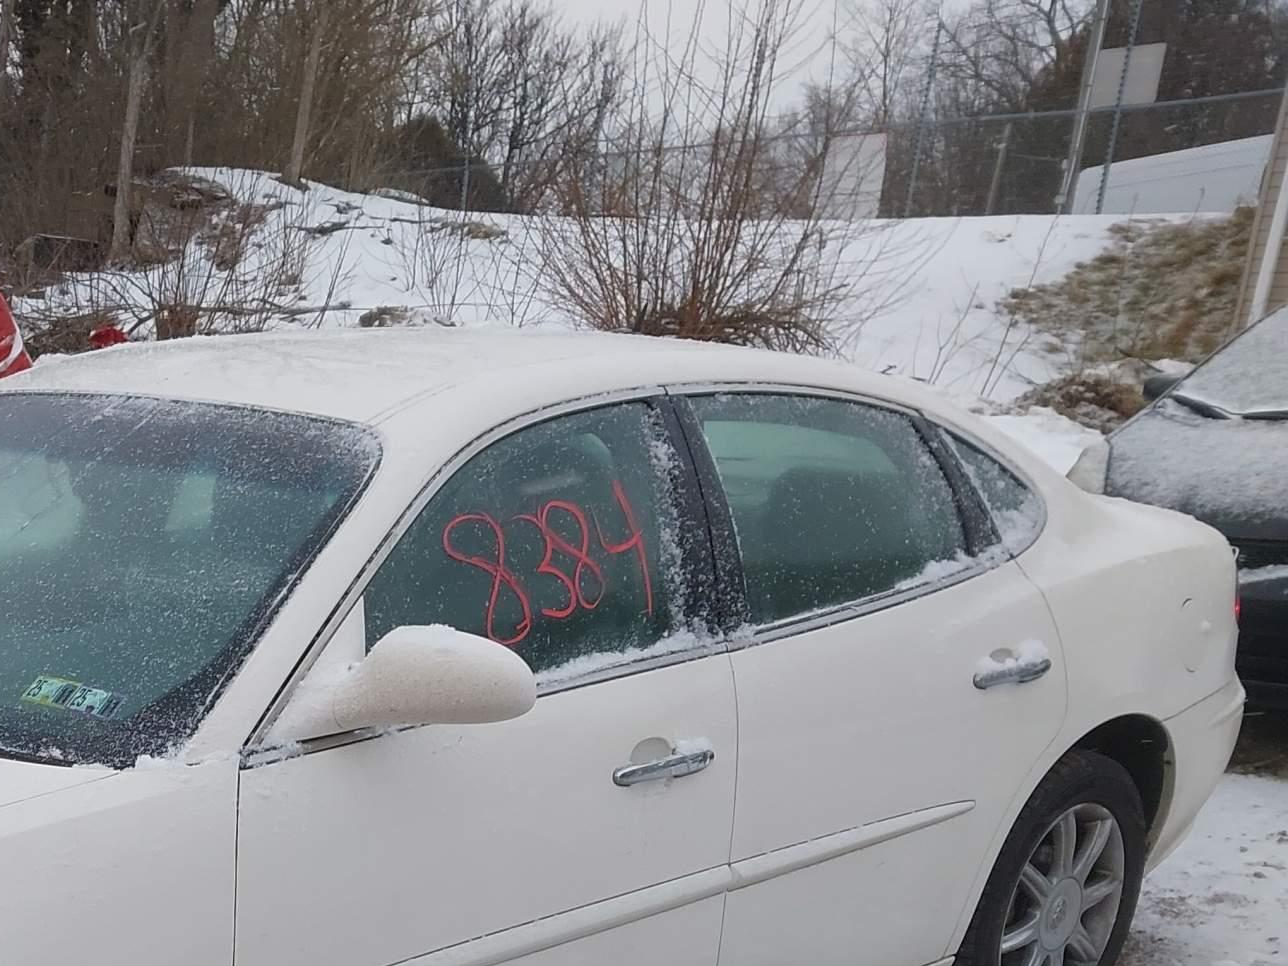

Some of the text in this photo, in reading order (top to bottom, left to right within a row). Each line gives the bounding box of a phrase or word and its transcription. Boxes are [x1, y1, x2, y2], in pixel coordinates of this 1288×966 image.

[442, 480, 654, 646] 8384
[26, 679, 48, 697] 25
[71, 688, 93, 707] 25
